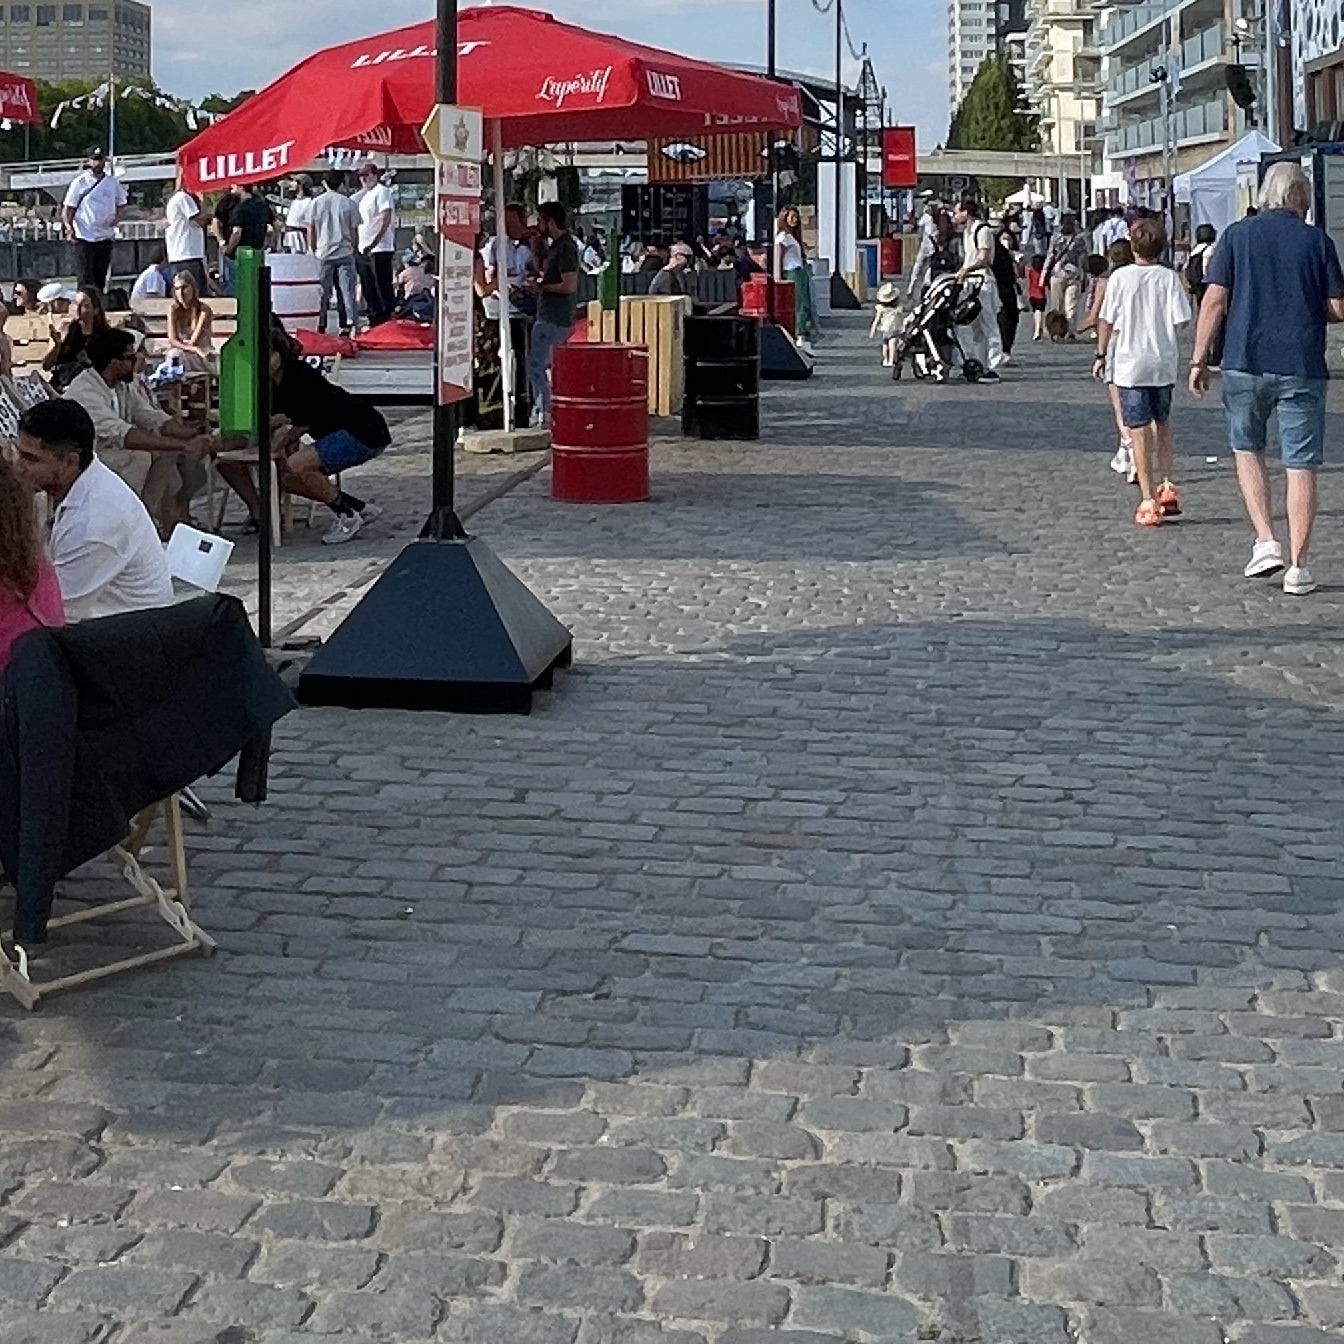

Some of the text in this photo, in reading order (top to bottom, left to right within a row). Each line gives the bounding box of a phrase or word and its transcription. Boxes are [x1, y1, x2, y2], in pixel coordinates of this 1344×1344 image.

[351, 41, 491, 69] LILLT
[645, 69, 682, 102] LILLET
[198, 140, 296, 182] LILLET
